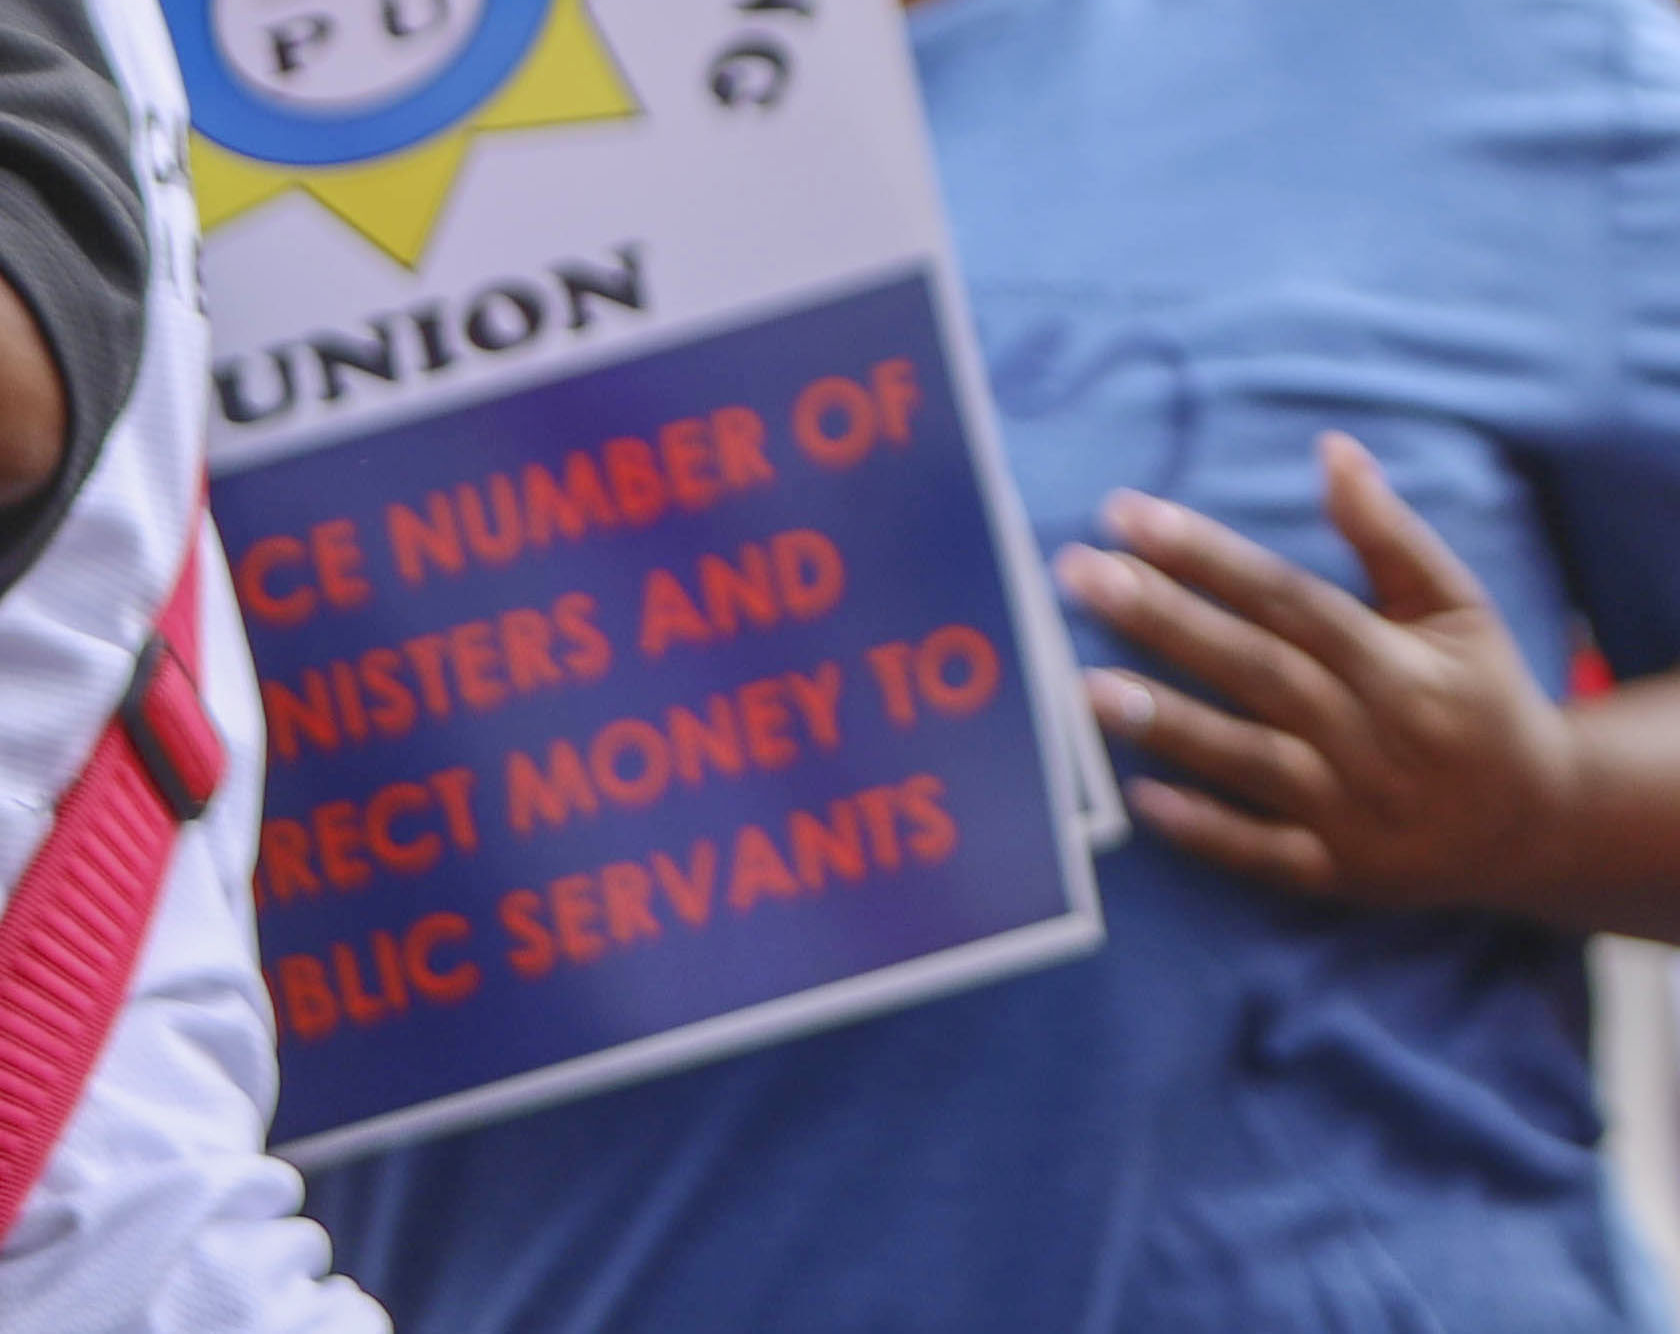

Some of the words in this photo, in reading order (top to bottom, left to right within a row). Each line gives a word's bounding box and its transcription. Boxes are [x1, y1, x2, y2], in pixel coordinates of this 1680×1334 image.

[211, 242, 649, 430] UNION
[239, 520, 370, 625] CE
[386, 407, 774, 583] NUMBER
[794, 359, 923, 465] OF
[255, 767, 480, 908] RECT
[504, 660, 844, 836] MONEY
[867, 625, 998, 728] TO
[264, 595, 610, 761] NISTERS
[639, 529, 846, 658] AND
[263, 911, 482, 1043] BLIC
[500, 775, 958, 981] SERVANTS
